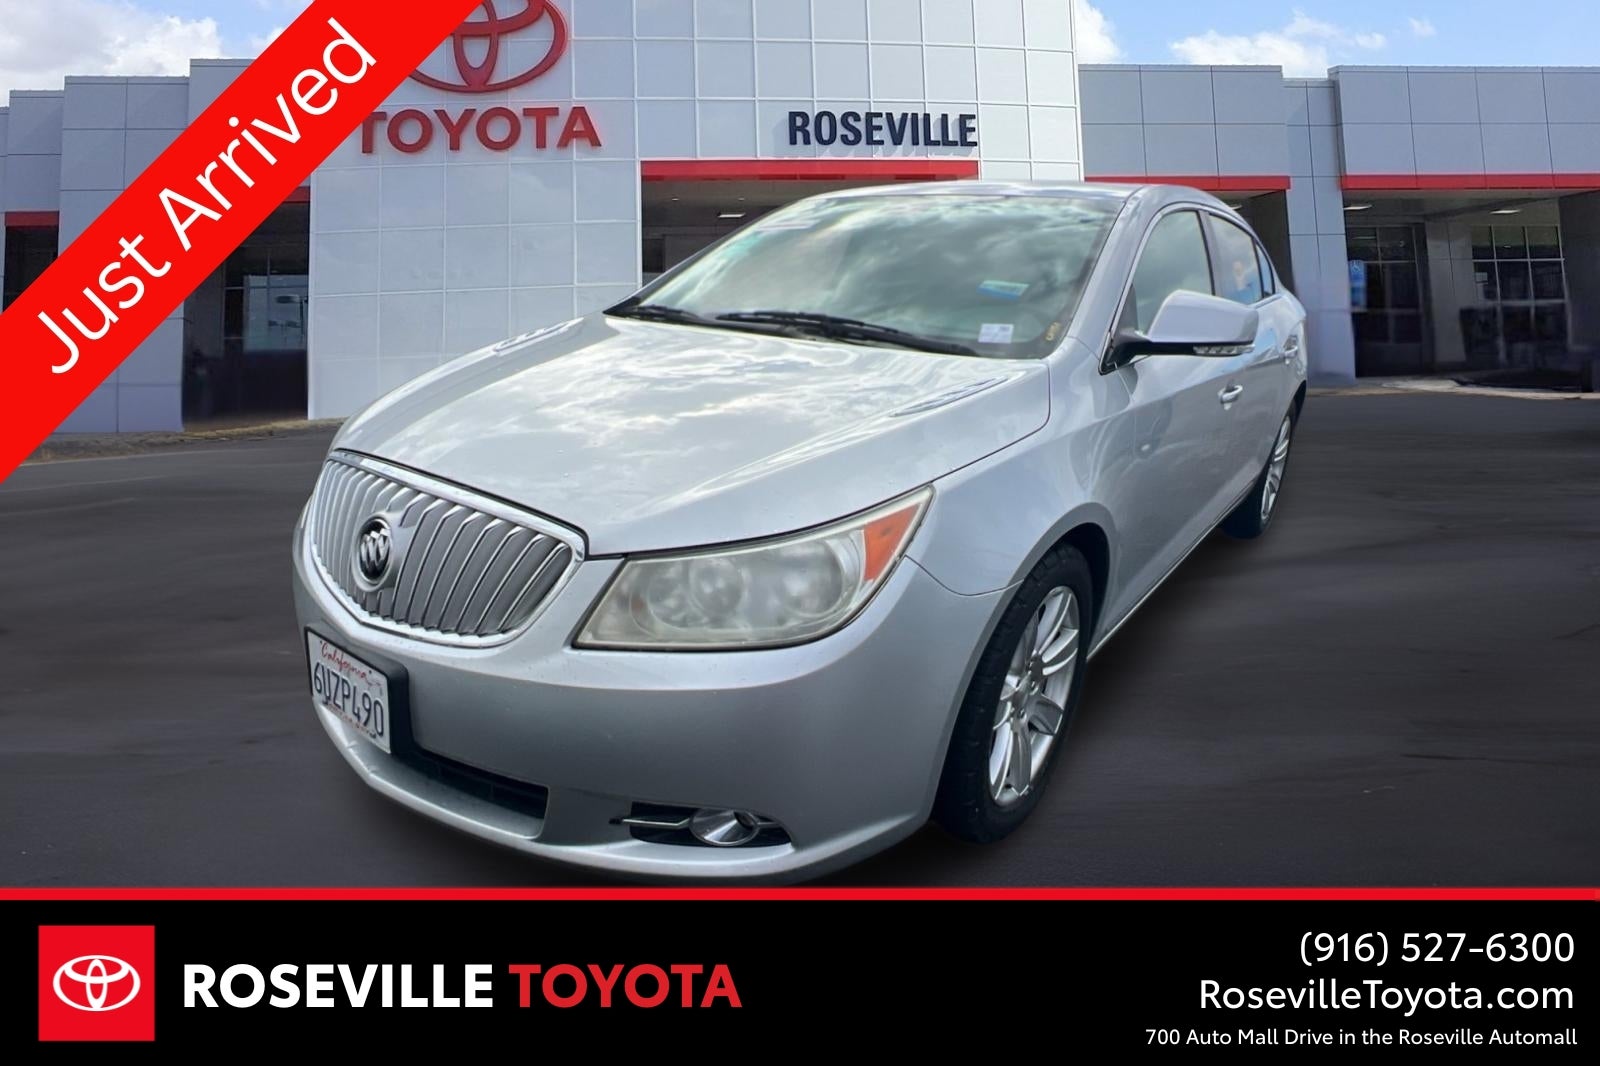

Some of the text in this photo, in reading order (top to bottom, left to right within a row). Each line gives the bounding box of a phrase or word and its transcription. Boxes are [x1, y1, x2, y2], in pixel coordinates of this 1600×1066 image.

[361, 106, 602, 153] TOYOTA
[788, 111, 978, 147] ROSEVILLE
[313, 662, 385, 737] 6UZP490
